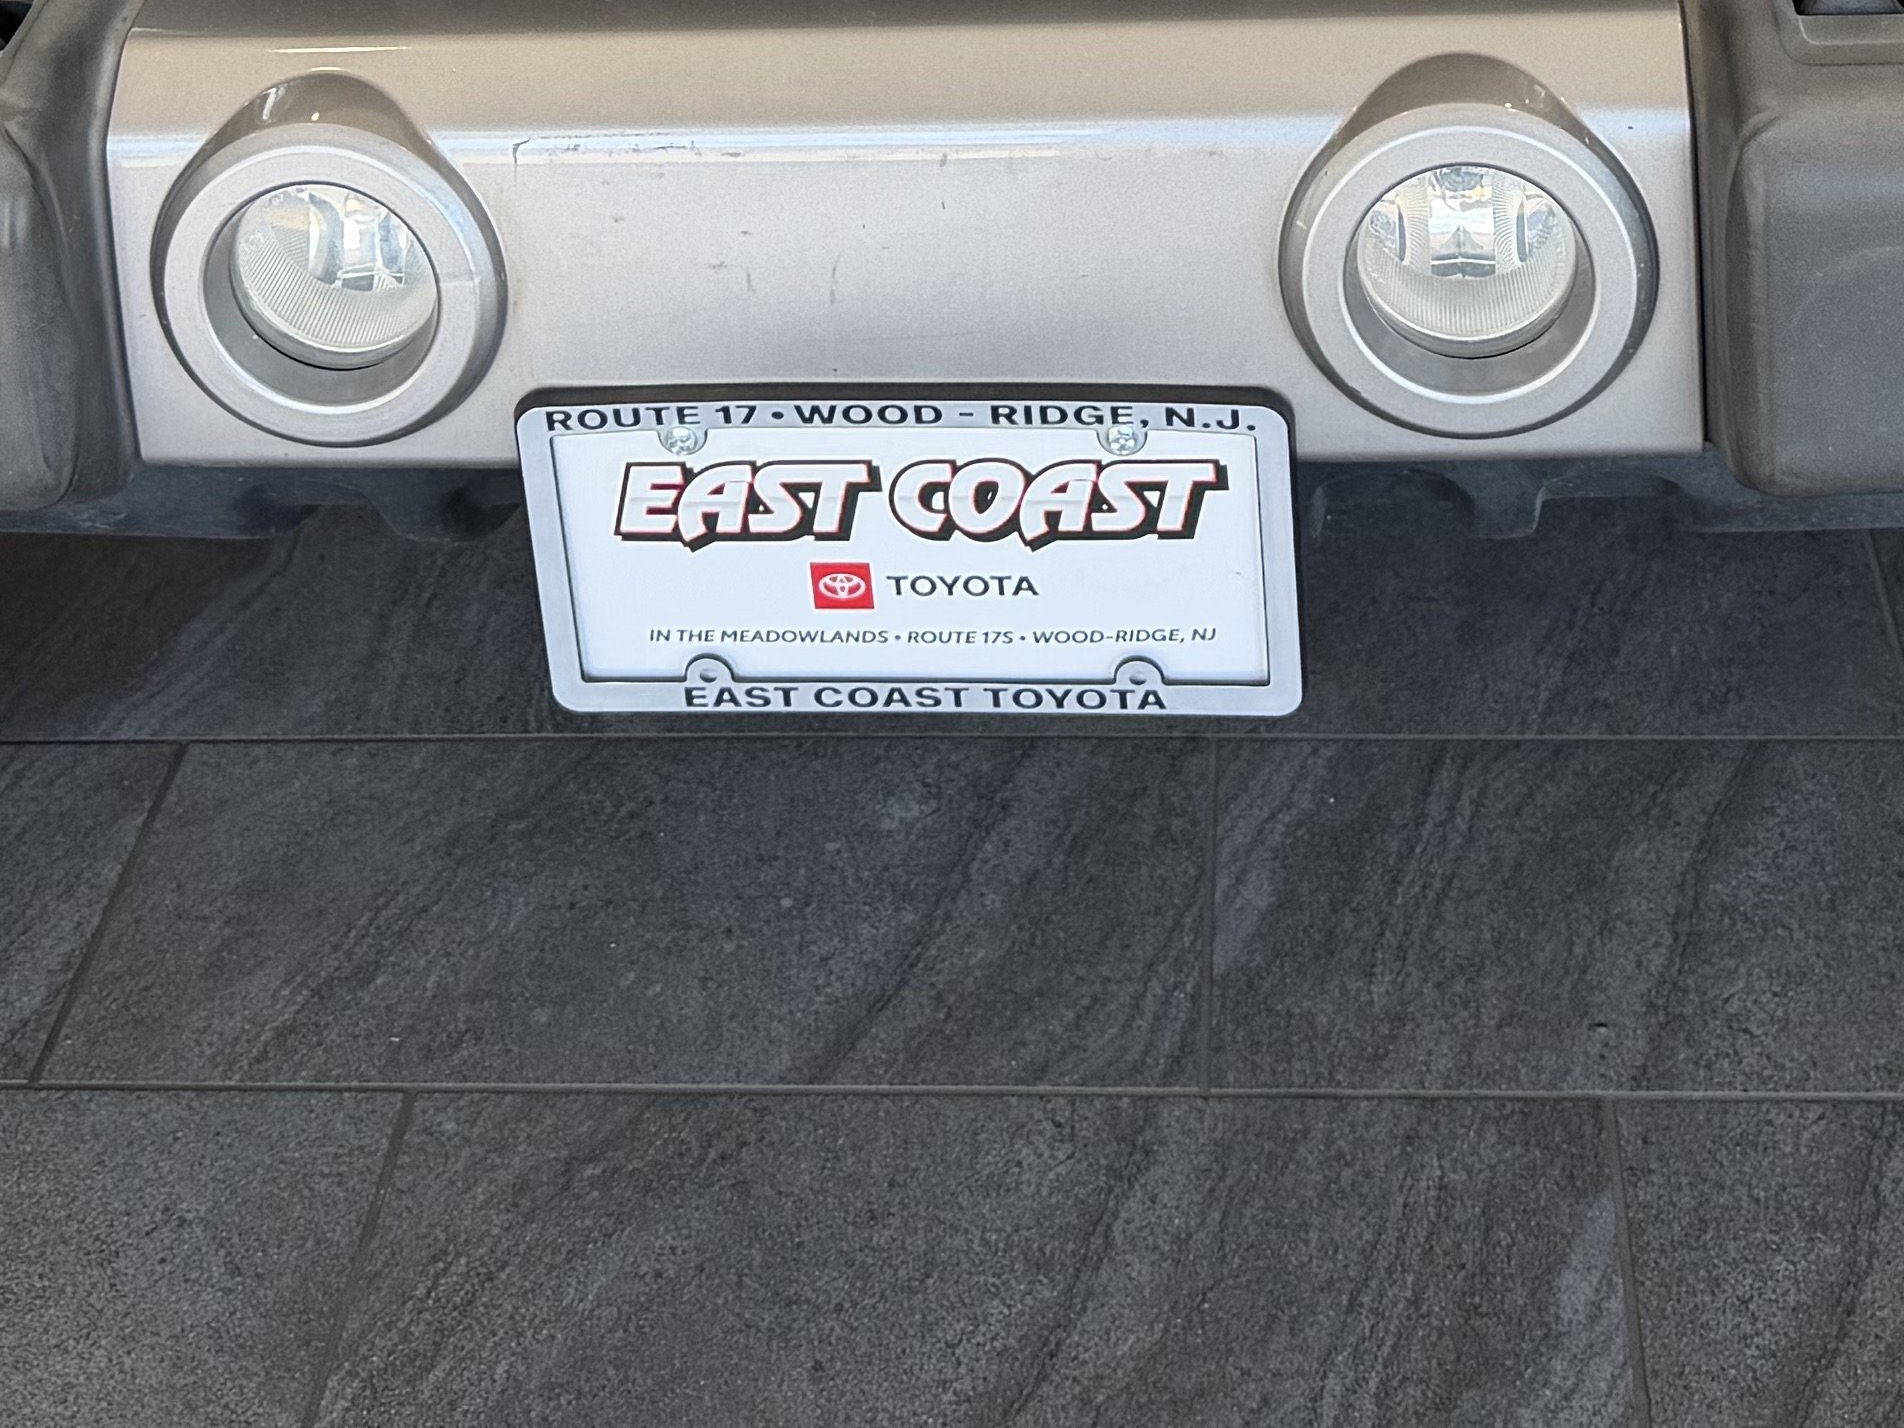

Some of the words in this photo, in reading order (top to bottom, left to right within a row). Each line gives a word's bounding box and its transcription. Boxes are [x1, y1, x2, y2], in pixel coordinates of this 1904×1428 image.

[546, 405, 703, 431] ROUTE
[714, 404, 757, 425] 17
[793, 404, 943, 425] WOOD
[990, 404, 1149, 428] RIDGE,
[1164, 408, 1256, 432] N.J.
[614, 459, 883, 552] EAST
[889, 457, 1229, 552] COAST
[886, 575, 1039, 597] TOYOTA
[649, 629, 671, 643] IN
[677, 629, 715, 642] THE
[720, 630, 889, 644] MEADOWLANDS
[907, 630, 977, 644] ROUTE
[982, 630, 1014, 644] 17S
[1033, 628, 1185, 644] WOOD-RIDGE,
[1191, 628, 1217, 642] NJ
[684, 687, 799, 708] EAST
[813, 687, 969, 708] COAST
[984, 688, 1167, 710] TOYOTA
